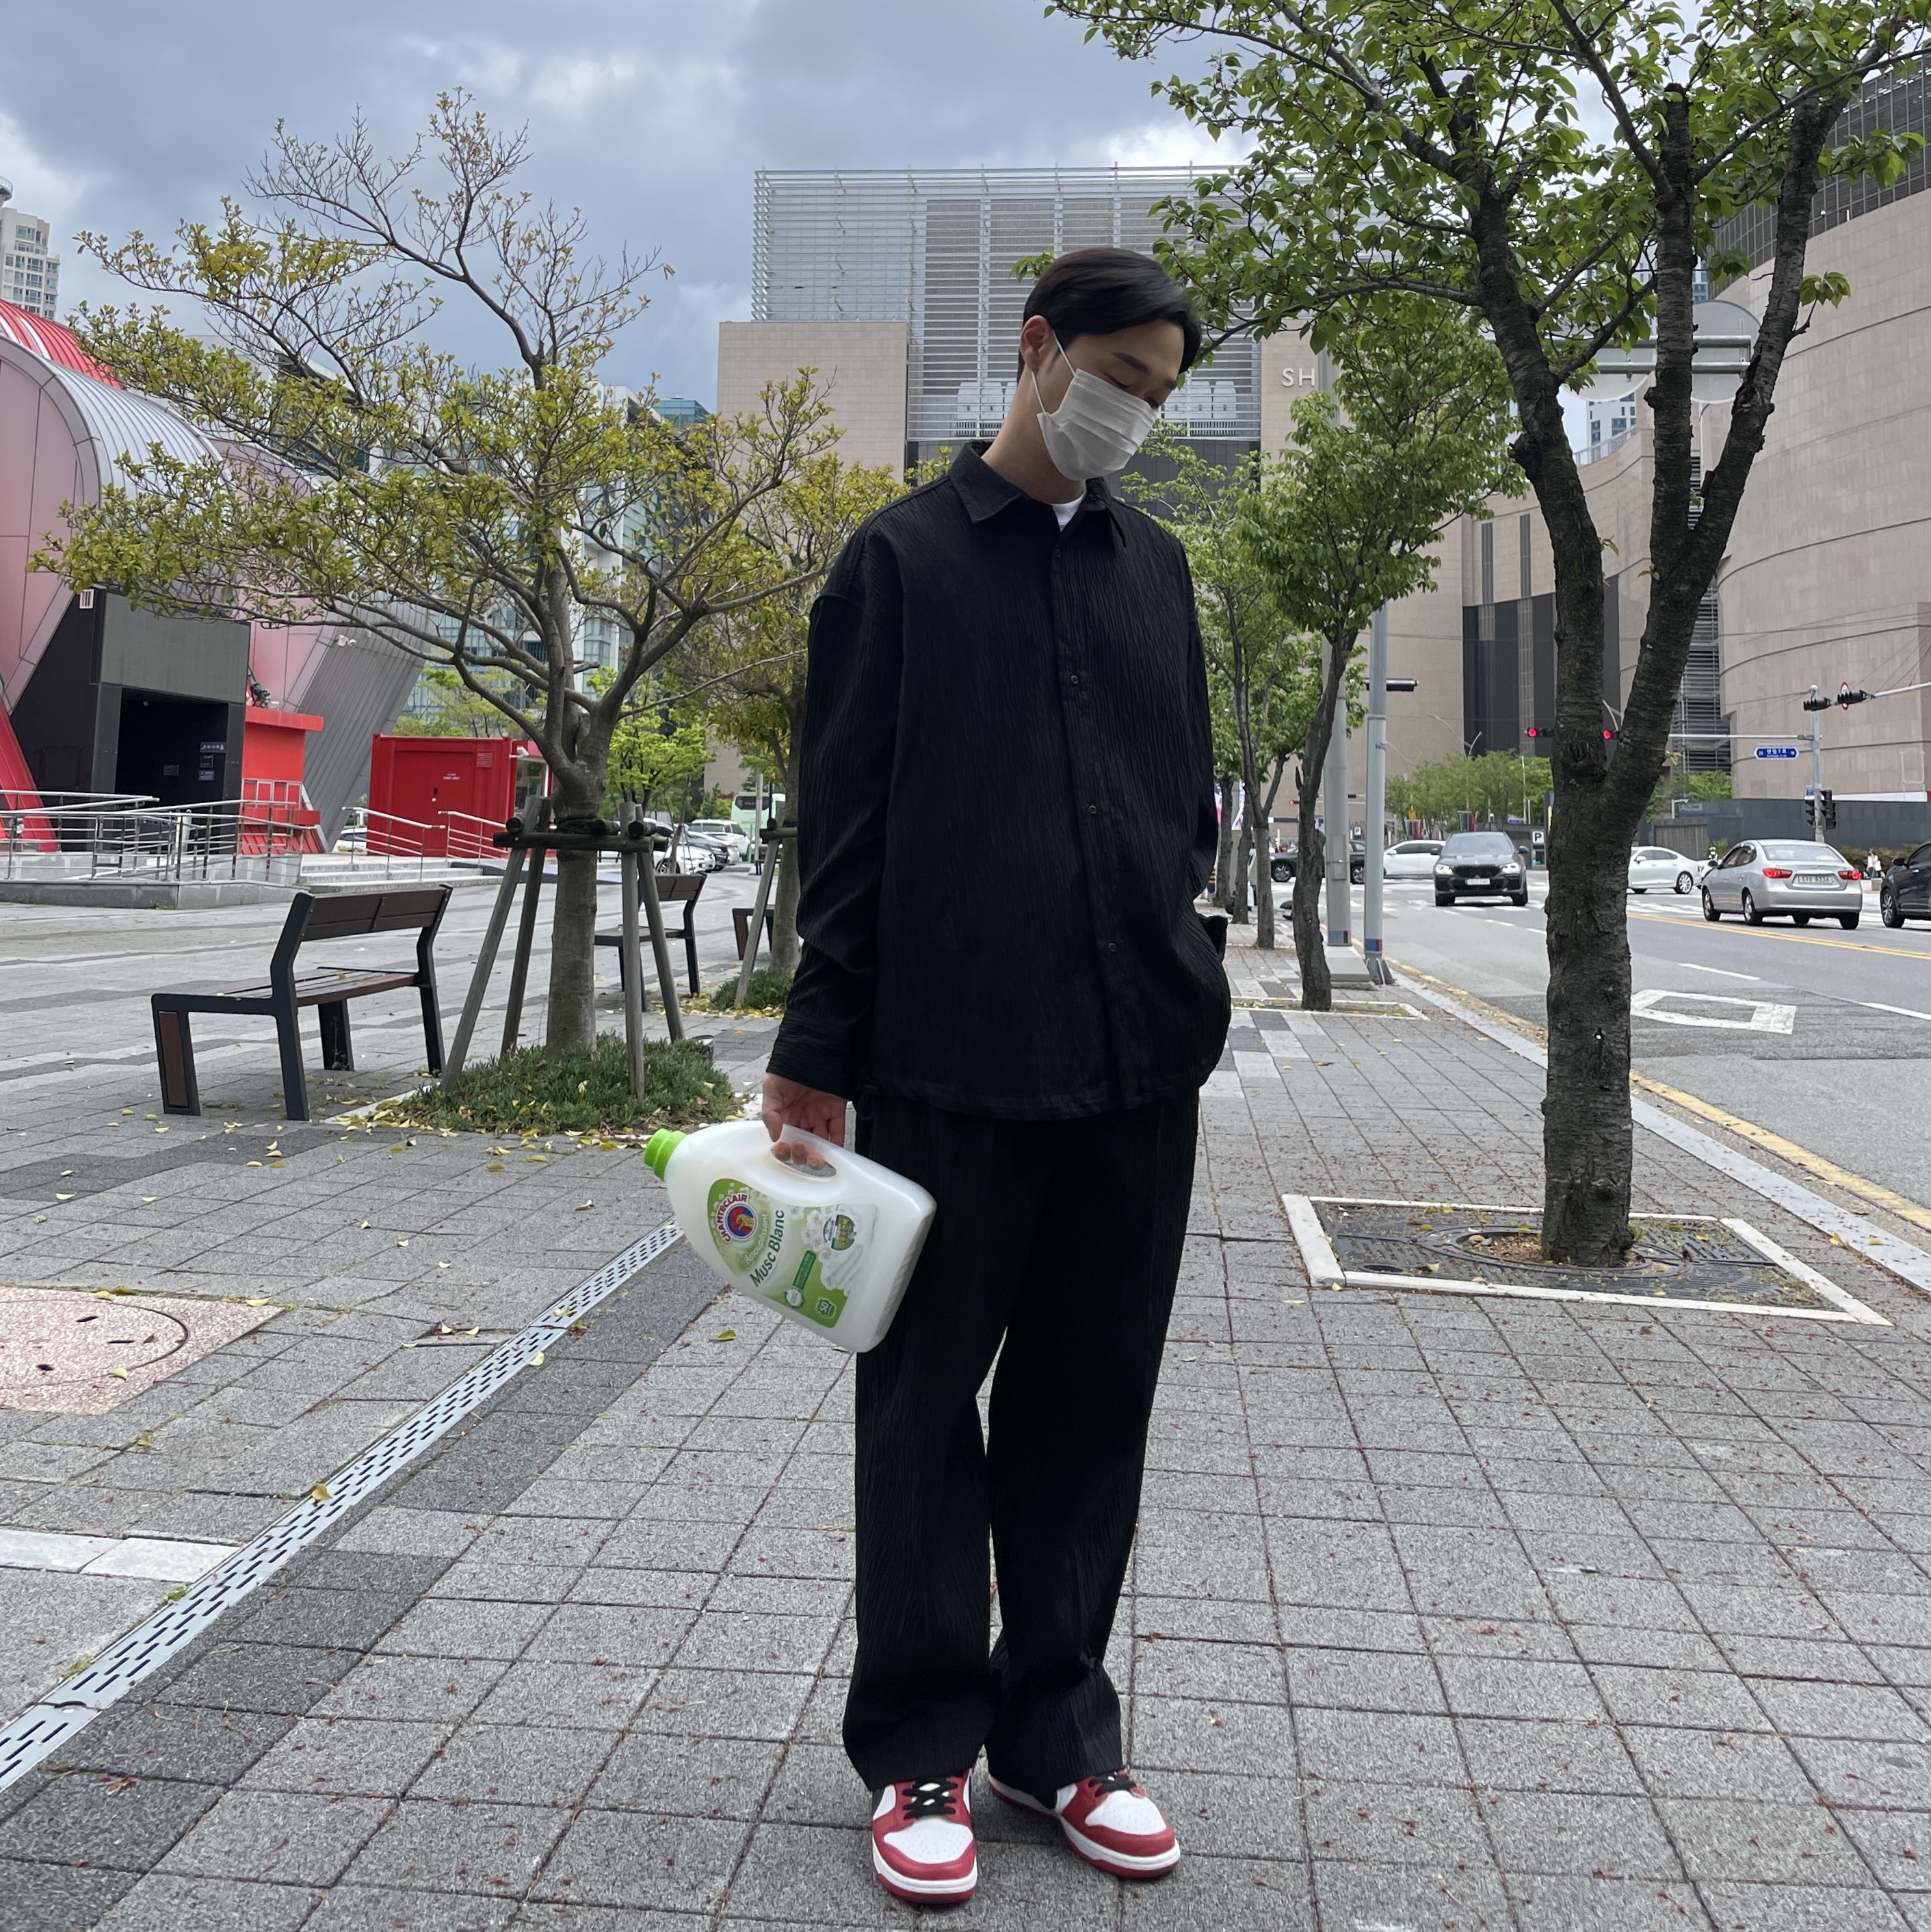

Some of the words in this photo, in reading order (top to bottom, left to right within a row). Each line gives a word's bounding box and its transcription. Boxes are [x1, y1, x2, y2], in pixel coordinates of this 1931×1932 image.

[1282, 367, 1315, 387] SH
[1534, 833, 1542, 841] P
[716, 1194, 748, 1242] CHANTECLAIR
[744, 1213, 769, 1265] Assouplissant
[750, 1252, 776, 1288] Musc
[768, 1210, 785, 1253] Blanc
